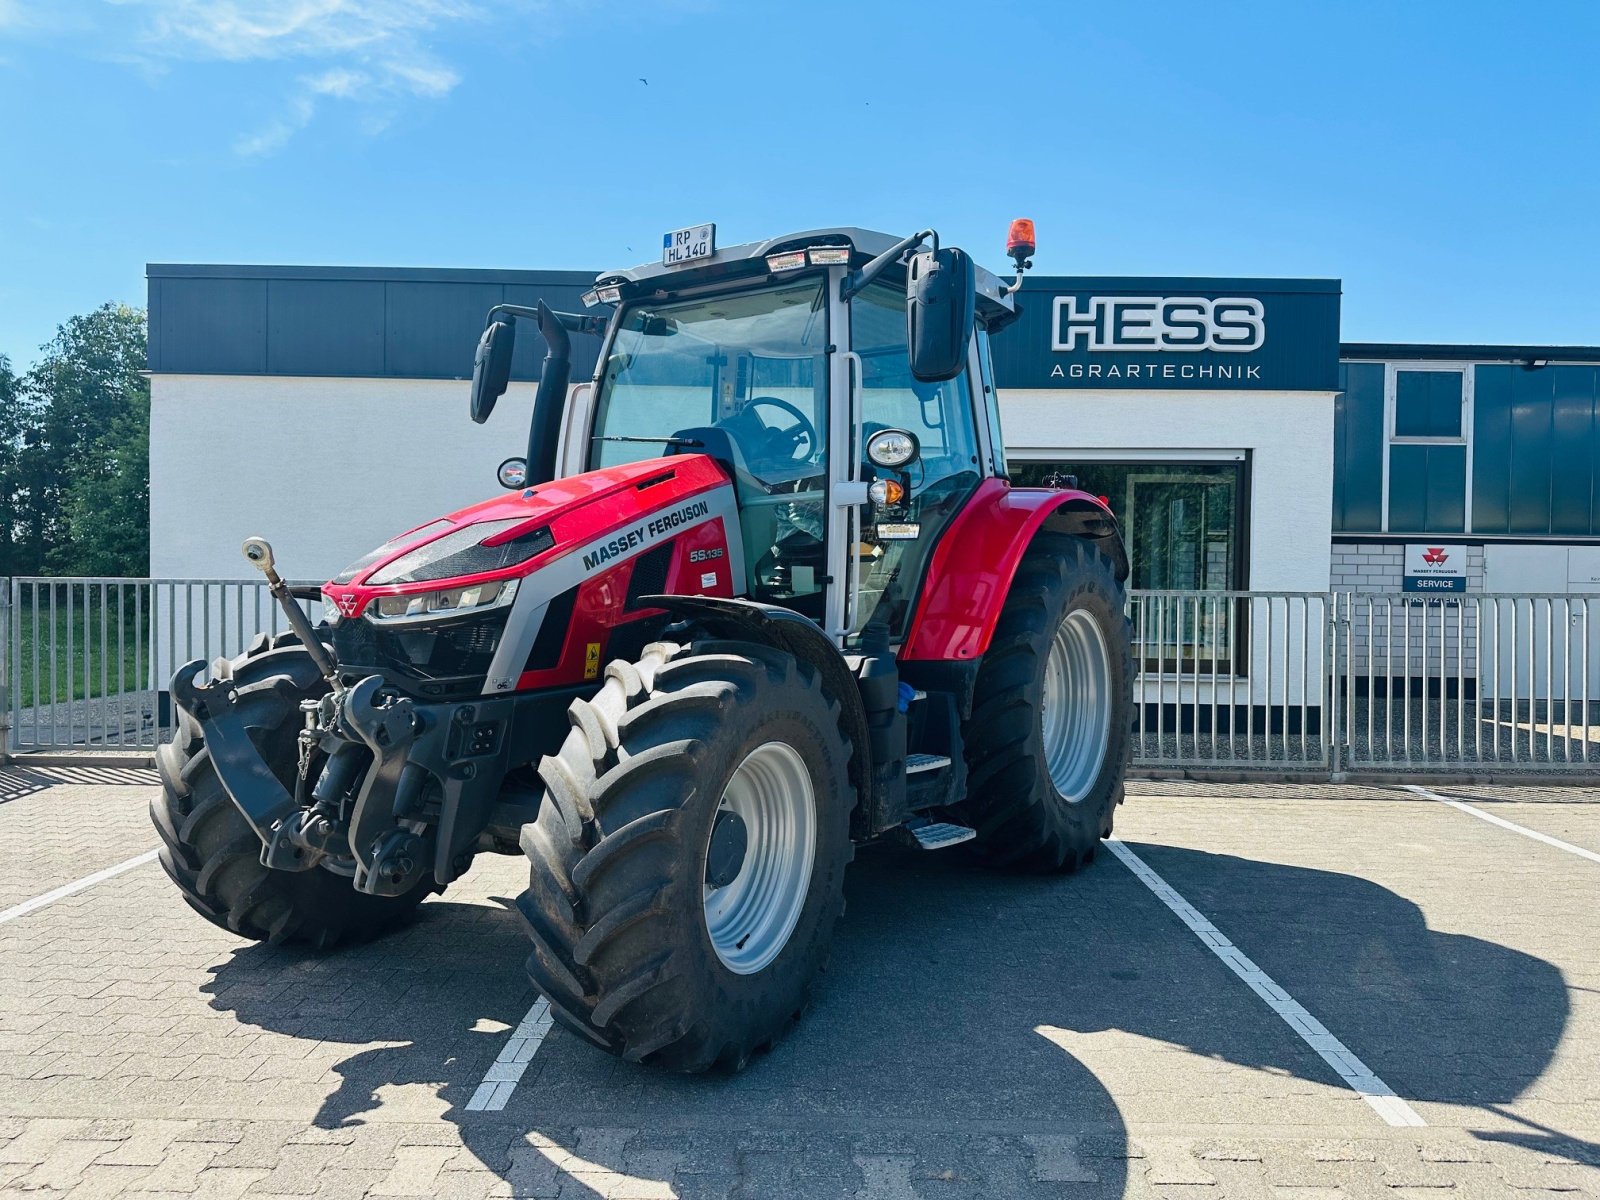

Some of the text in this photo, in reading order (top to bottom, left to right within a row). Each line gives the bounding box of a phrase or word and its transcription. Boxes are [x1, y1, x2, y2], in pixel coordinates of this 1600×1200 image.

[677, 231, 691, 246] RP
[668, 242, 706, 262] HL 140
[1051, 295, 1265, 352] HESS
[1050, 364, 1262, 379] AGRARTECHNIK
[582, 500, 709, 571] MASSEY FERGUSON
[690, 548, 723, 563] 5S.135
[1417, 580, 1454, 588] SERVICE
